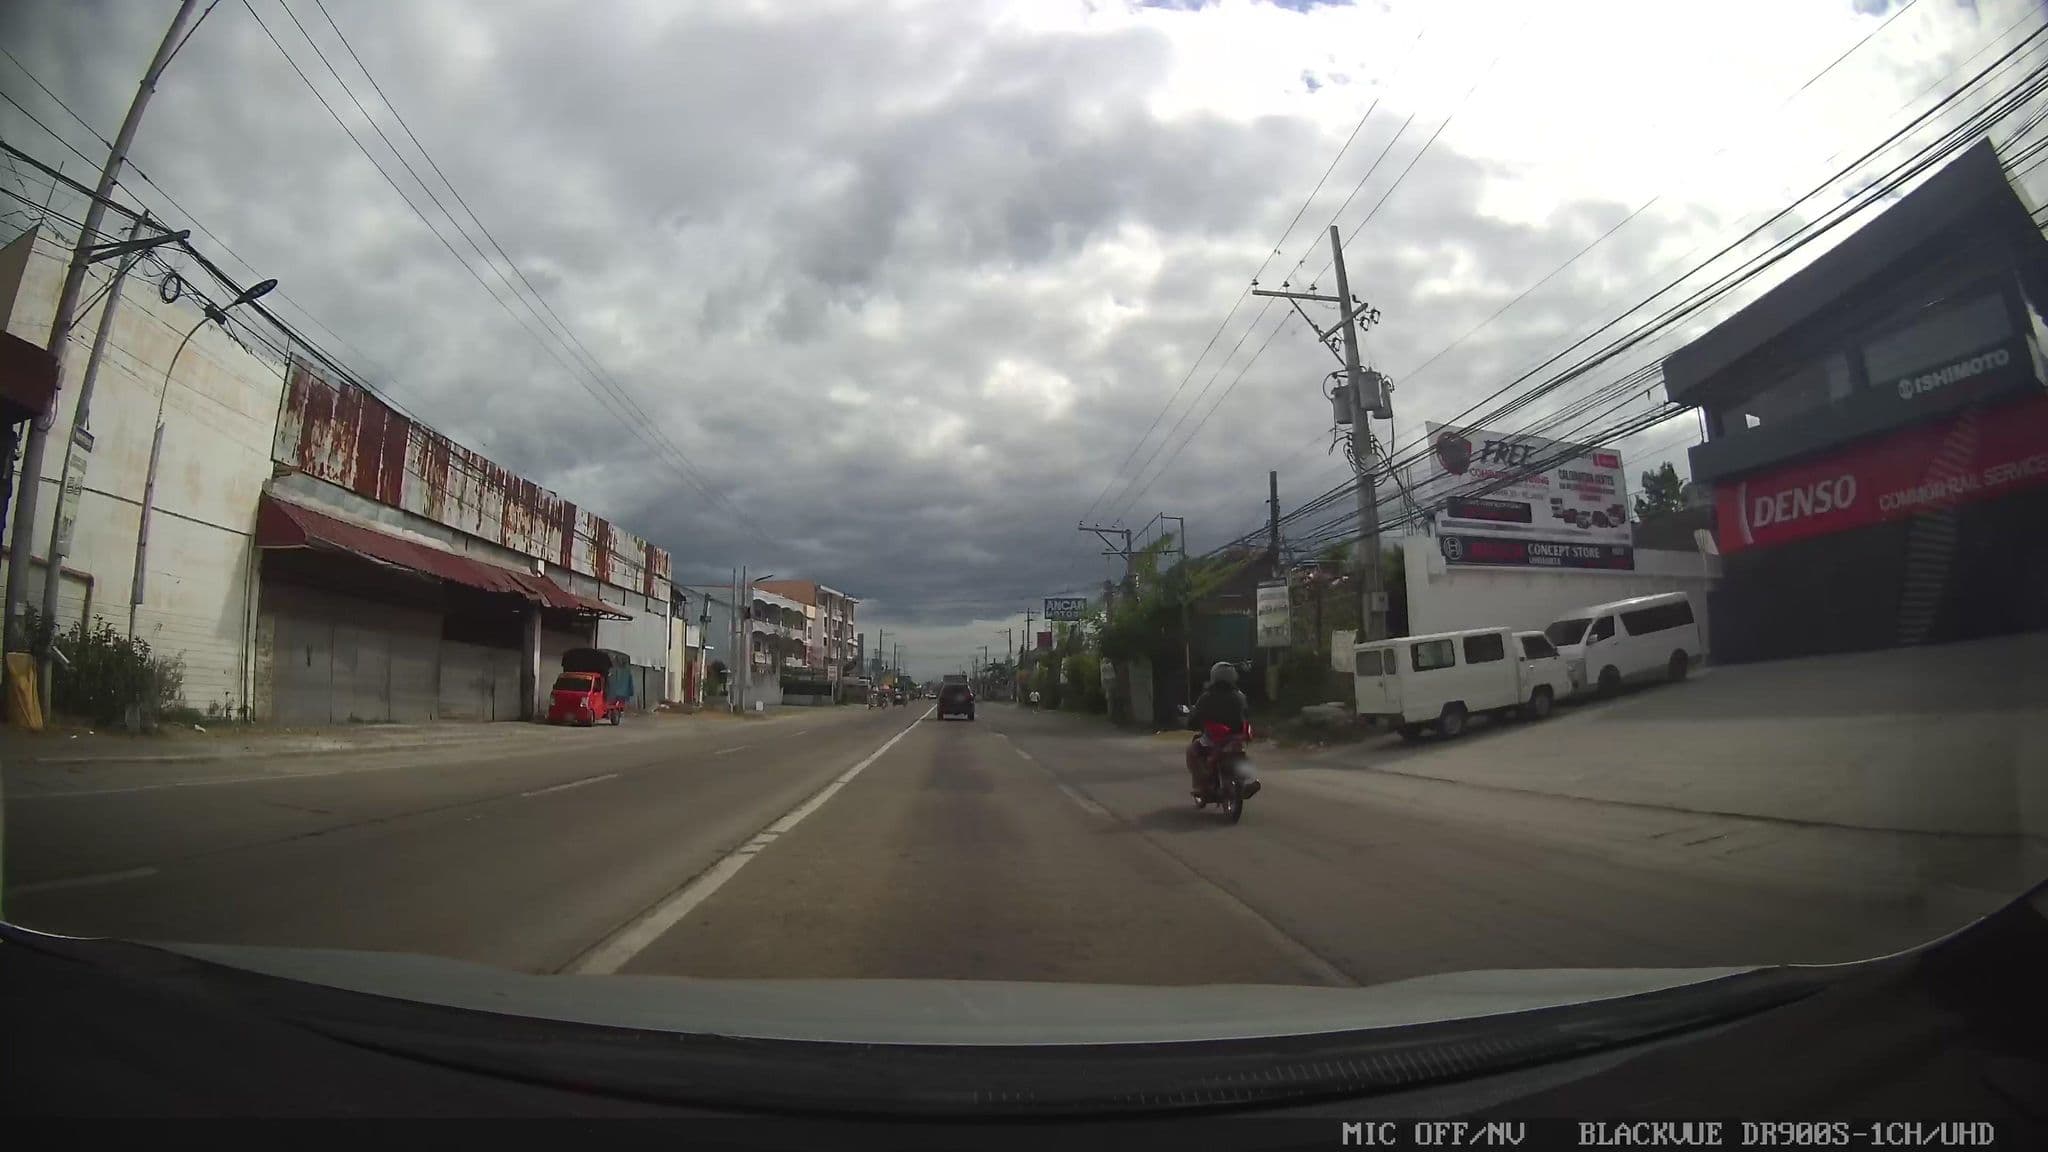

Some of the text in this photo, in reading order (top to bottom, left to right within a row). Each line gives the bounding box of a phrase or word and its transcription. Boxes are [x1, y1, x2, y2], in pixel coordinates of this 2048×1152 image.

[1915, 350, 2008, 392] ISHIMOTO
[1481, 440, 1536, 466] FREE
[1753, 475, 1857, 528] DENSO
[1527, 543, 1570, 557] CONCEPT
[1572, 546, 1601, 559] STORE
